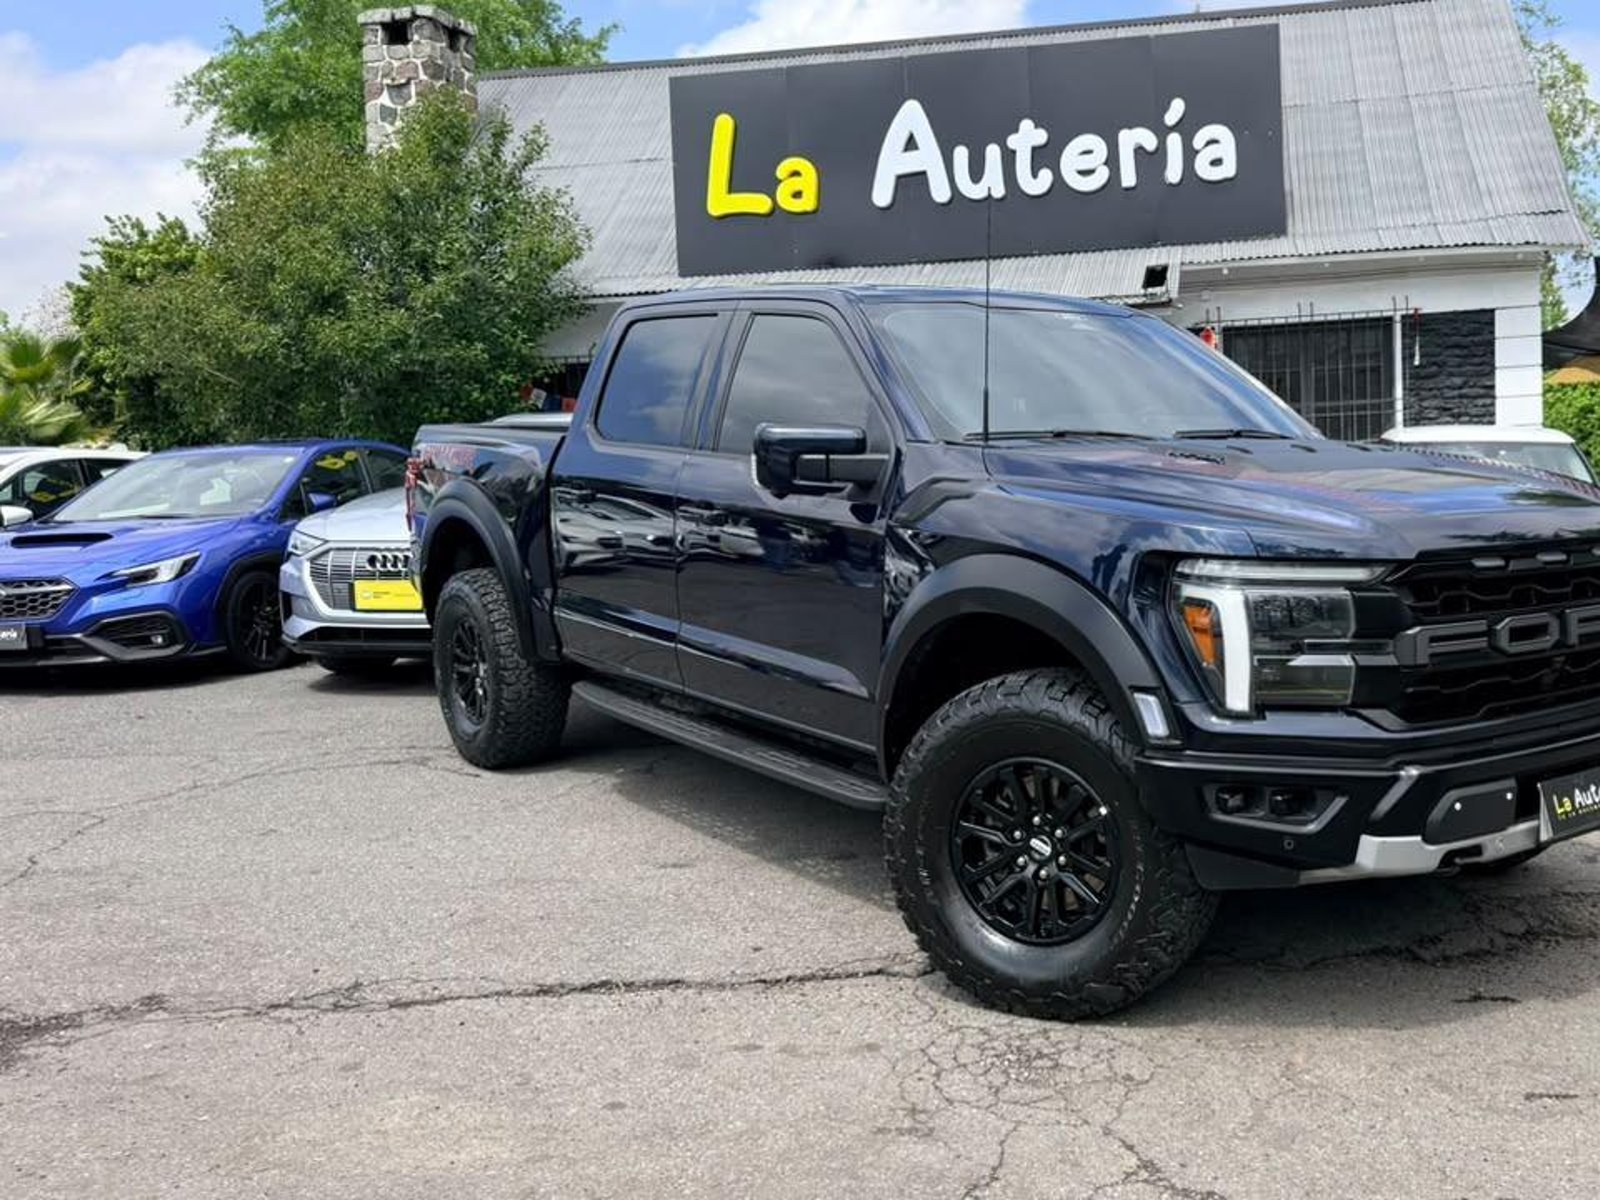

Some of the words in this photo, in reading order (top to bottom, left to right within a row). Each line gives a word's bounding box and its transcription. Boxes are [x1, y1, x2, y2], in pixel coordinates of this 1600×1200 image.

[707, 113, 818, 217] La
[872, 97, 1238, 208] Autería
[1552, 794, 1573, 814] La
[1574, 783, 1600, 808] Aut
